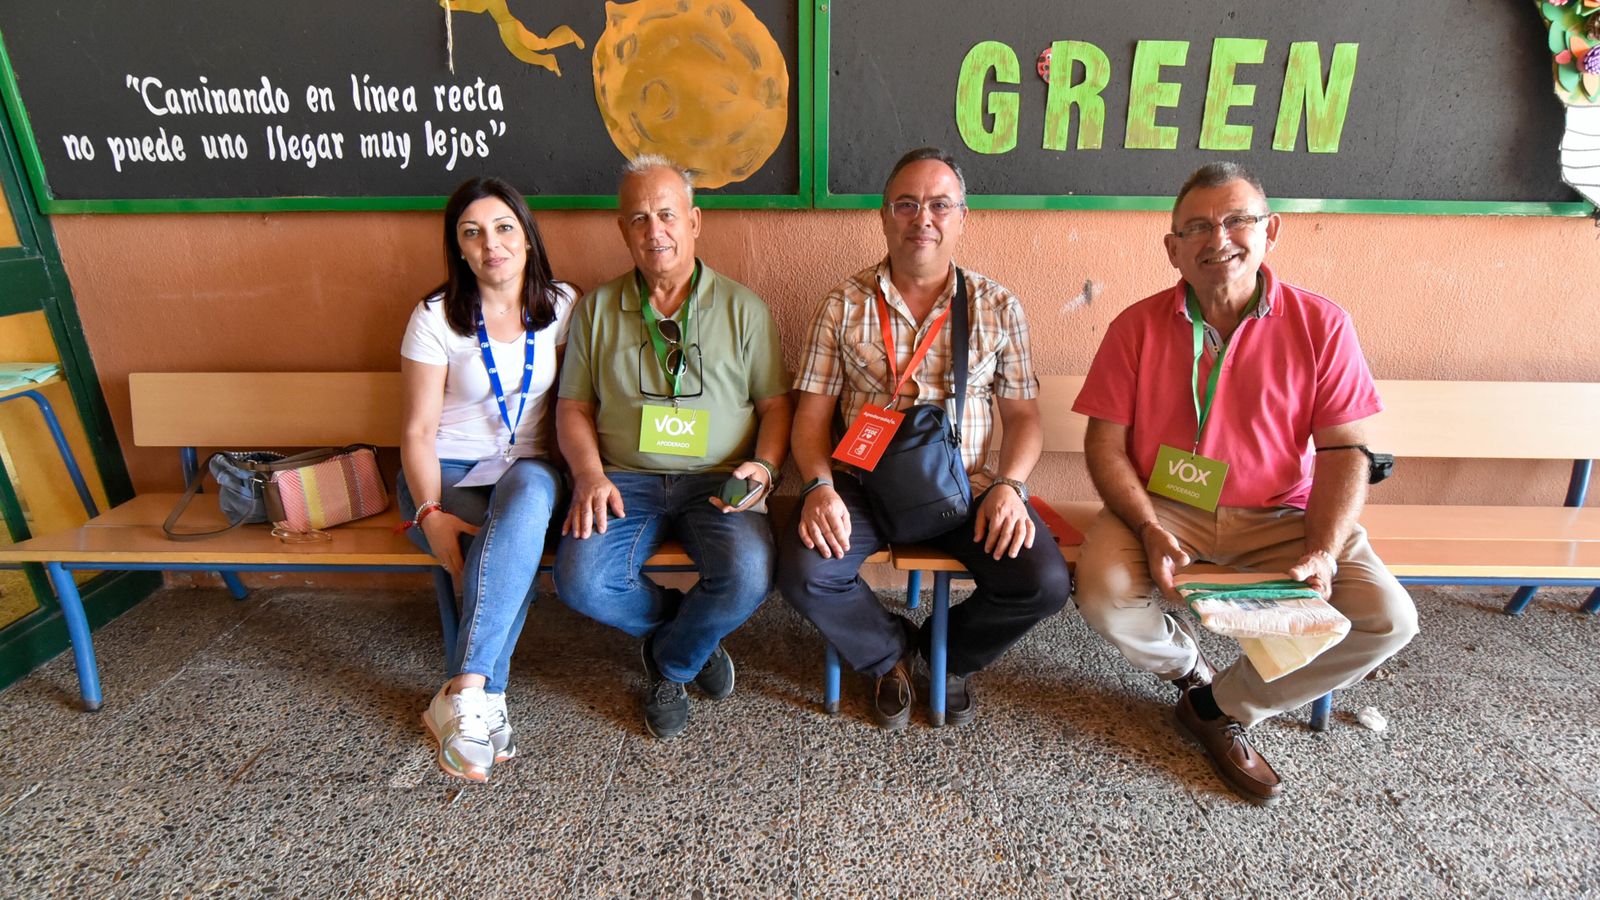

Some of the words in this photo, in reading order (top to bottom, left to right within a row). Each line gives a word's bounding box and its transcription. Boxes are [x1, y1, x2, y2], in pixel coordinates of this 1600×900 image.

[306, 84, 336, 113] en
[350, 73, 418, 114] línea
[433, 76, 504, 113] recta
[956, 37, 1359, 154] GREEN
[62, 134, 95, 161] no
[106, 127, 187, 173] puede
[200, 133, 249, 160] uno
[266, 124, 345, 169] llegar
[359, 131, 411, 170] muy
[654, 414, 697, 436] VOX
[656, 440, 690, 448] APODERADO
[1168, 458, 1212, 487] VOX
[1166, 483, 1200, 499] APODERADO
